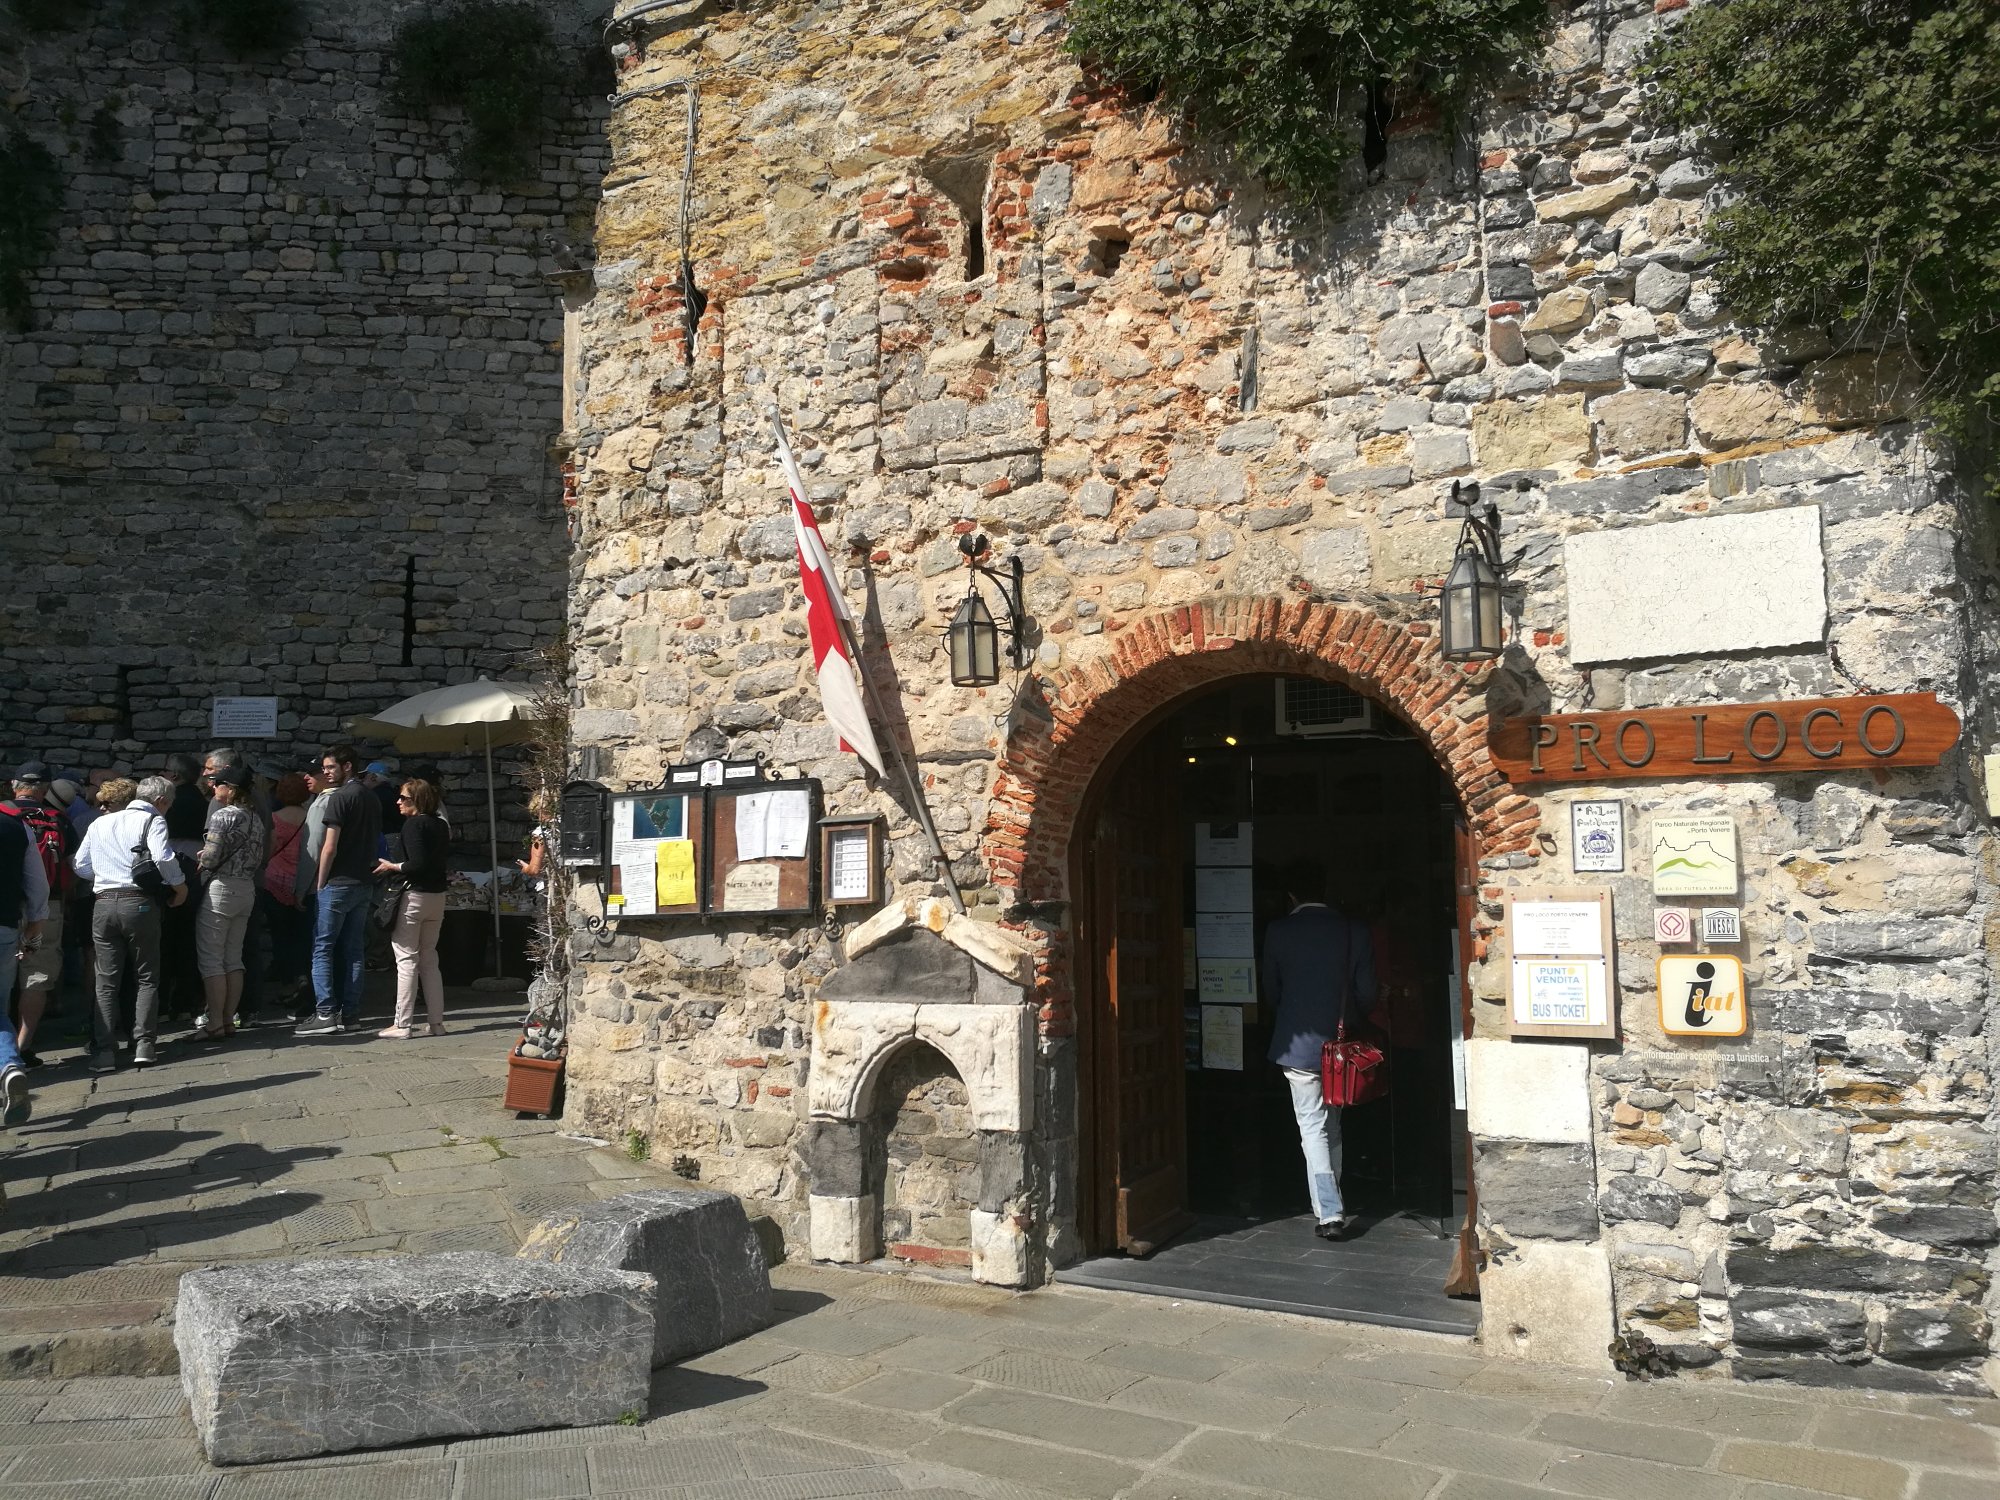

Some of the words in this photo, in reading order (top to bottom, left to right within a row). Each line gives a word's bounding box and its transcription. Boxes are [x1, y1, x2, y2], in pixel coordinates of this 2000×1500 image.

[1528, 718, 1655, 773] PRO
[1691, 704, 1905, 763] LOCO
[1699, 819, 1730, 827] Regionale
[1707, 919, 1736, 934] UNESCO
[1692, 988, 1735, 1012] iat
[1532, 1004, 1551, 1017] BUS
[1553, 1004, 1586, 1018] TICKET
[1690, 1051, 1735, 1062] accoglienza
[1737, 1052, 1770, 1063] turistica
